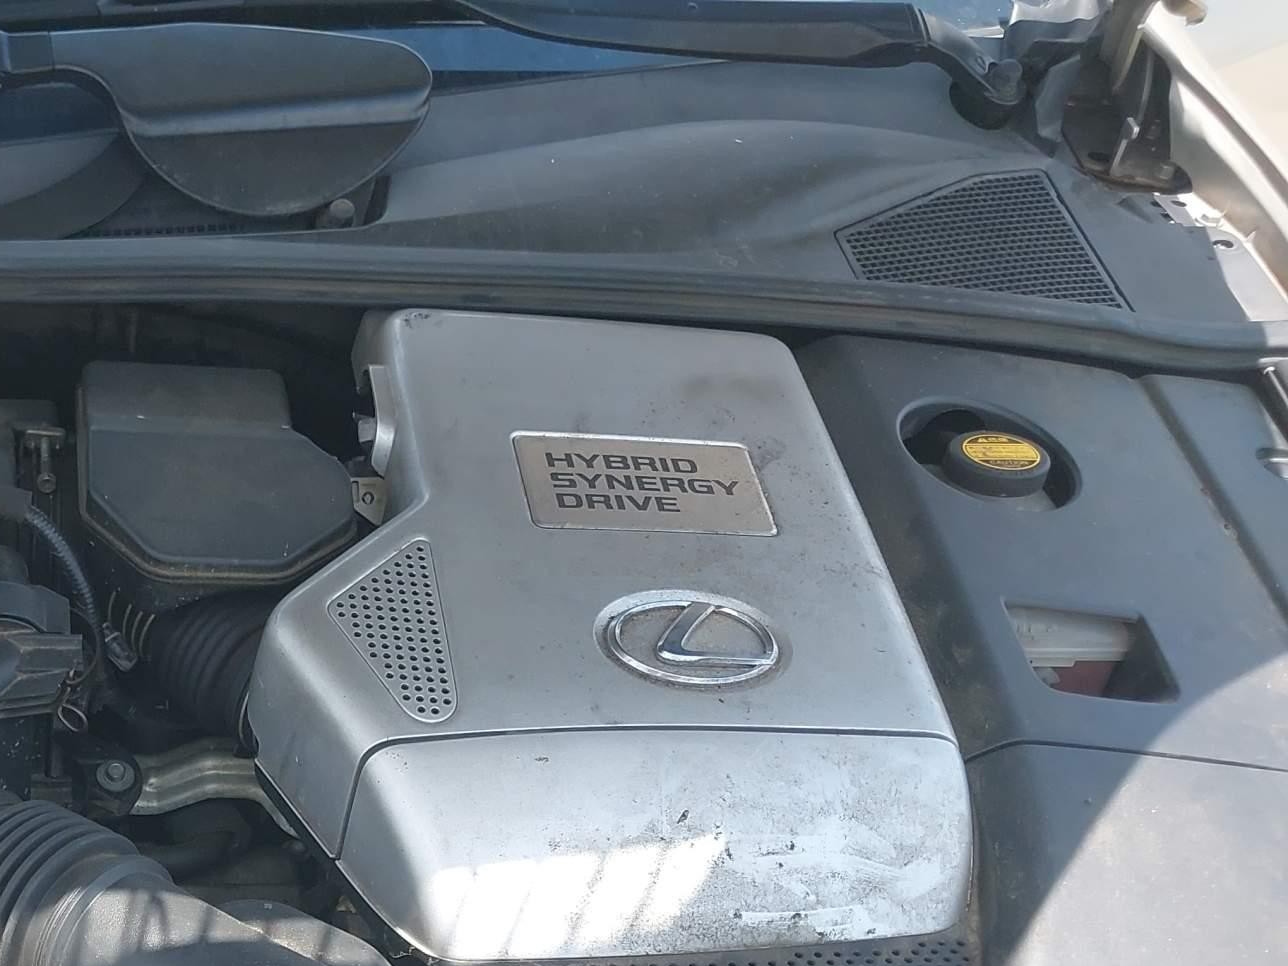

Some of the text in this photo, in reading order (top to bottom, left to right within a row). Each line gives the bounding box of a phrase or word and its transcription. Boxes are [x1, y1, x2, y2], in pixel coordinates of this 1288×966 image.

[544, 452, 698, 474] HYBRID
[549, 472, 739, 496] SYNERGY
[555, 493, 681, 513] DRIVE
